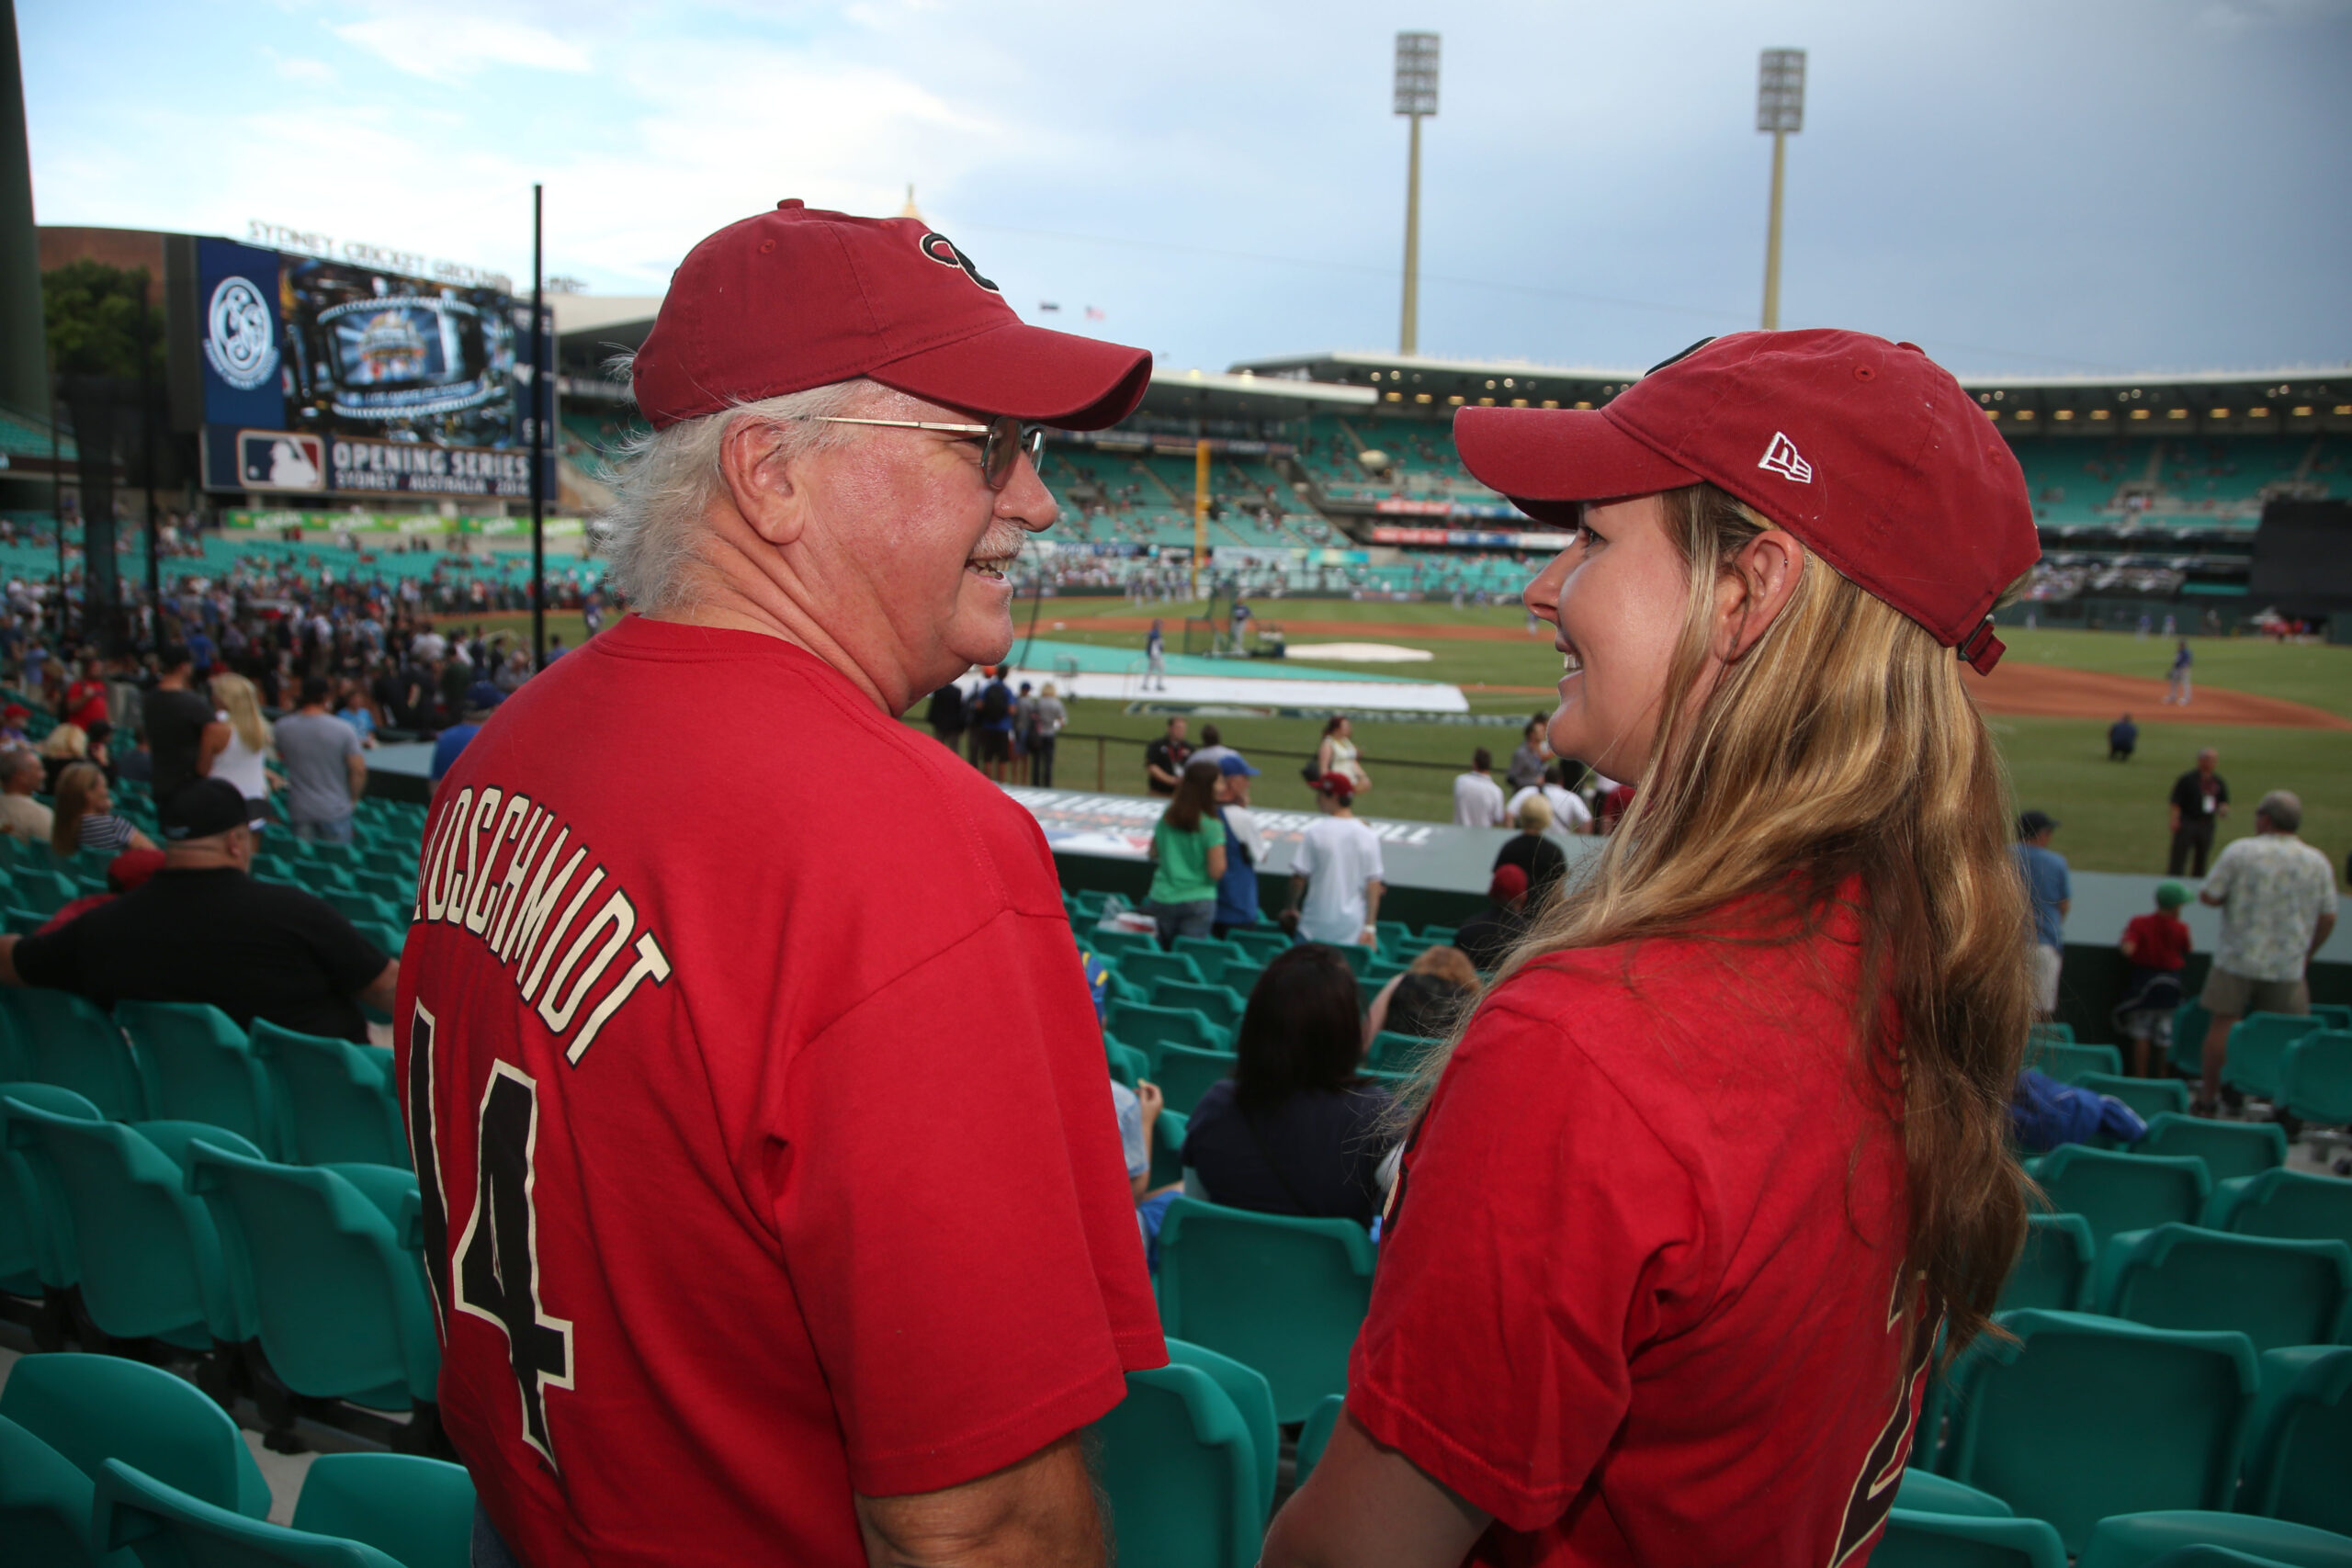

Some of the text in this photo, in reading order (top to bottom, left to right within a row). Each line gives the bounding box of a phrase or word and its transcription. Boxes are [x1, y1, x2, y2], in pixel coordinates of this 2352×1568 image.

[249, 220, 334, 254] SYDNEY
[333, 442, 531, 479] OPENING SERIES
[335, 468, 397, 491] SYDNEY
[408, 472, 488, 493] AUSTRALIA
